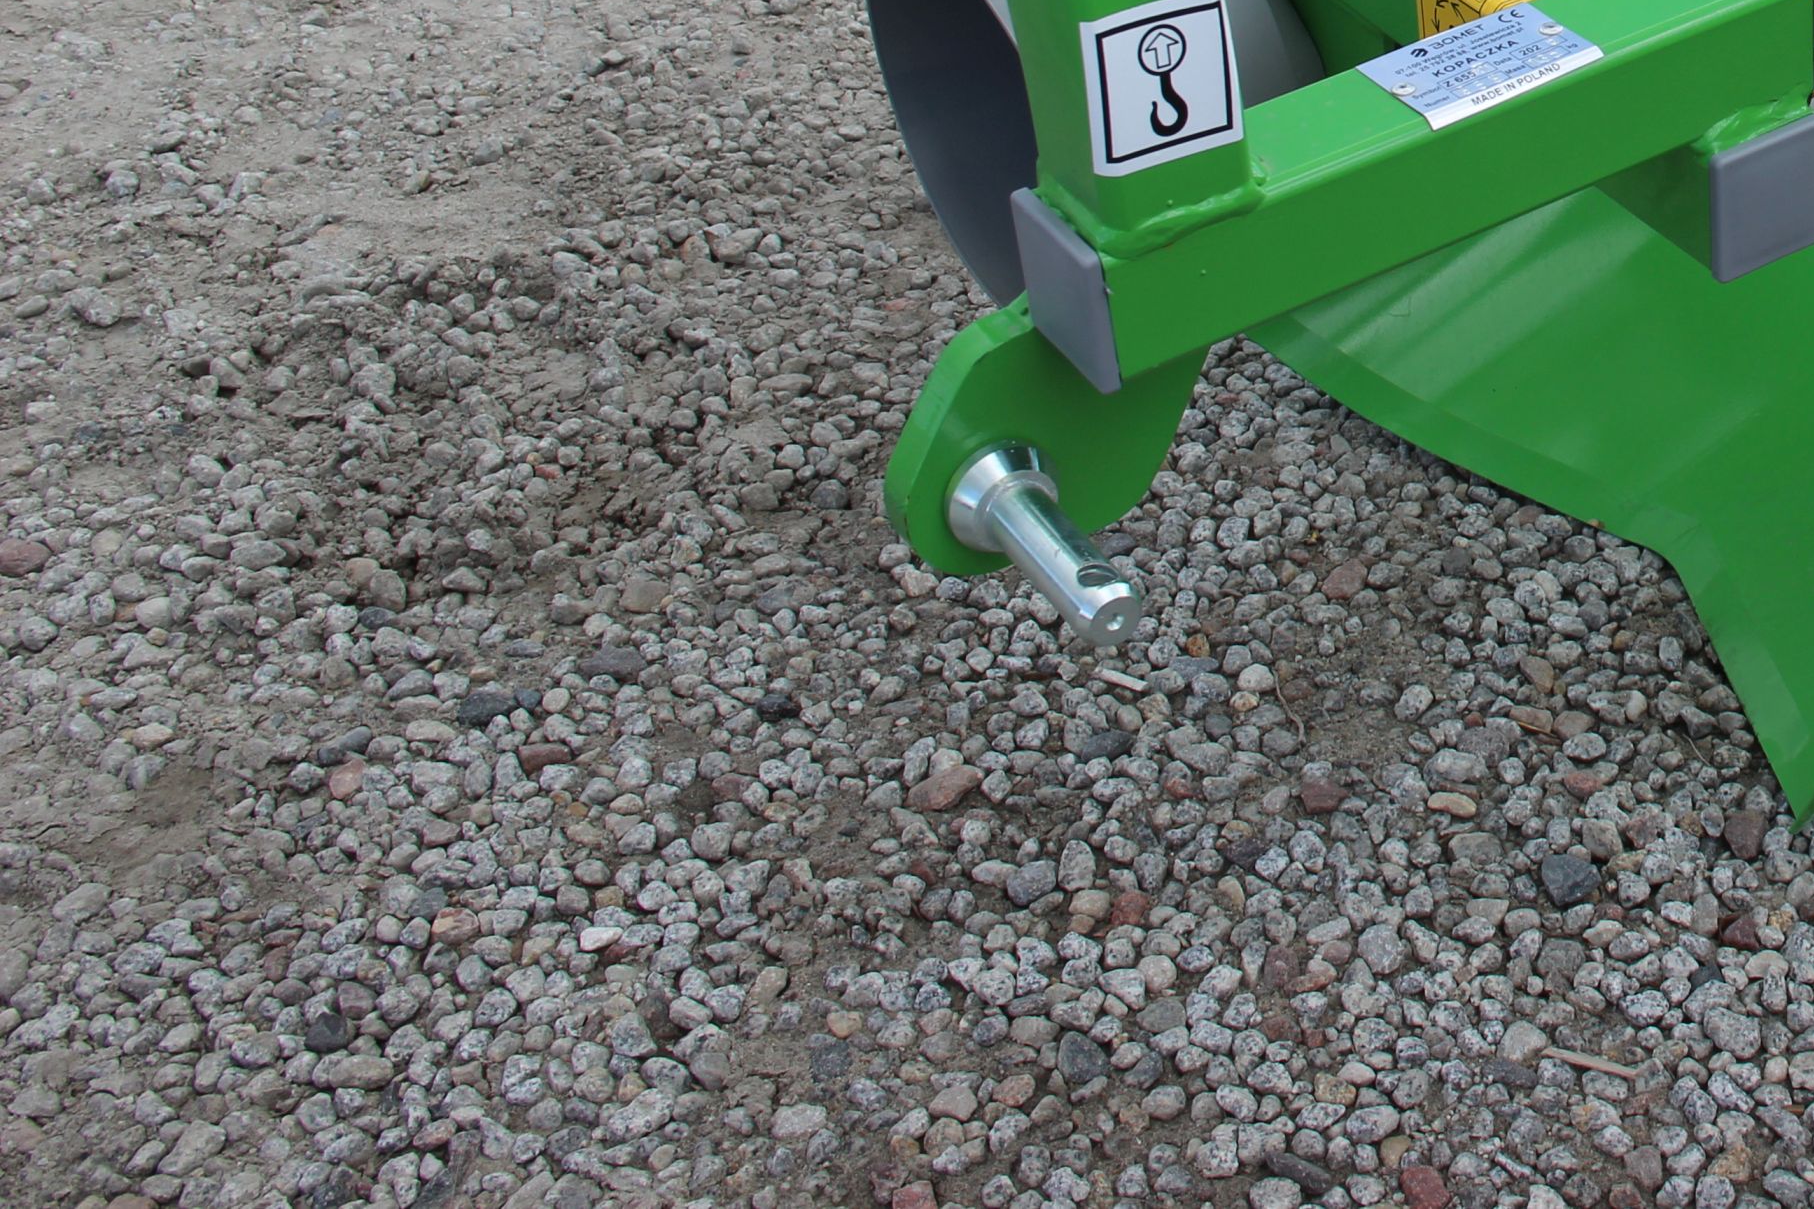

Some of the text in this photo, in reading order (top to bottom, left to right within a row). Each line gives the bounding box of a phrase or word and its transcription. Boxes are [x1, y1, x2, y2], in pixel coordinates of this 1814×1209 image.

[1428, 24, 1484, 50] BOMET
[1432, 39, 1519, 78] KOPACZKA
[1493, 56, 1513, 67] Data
[1471, 87, 1504, 106] MADE
[1505, 81, 1516, 93] IN
[1517, 62, 1561, 87] POLAND
